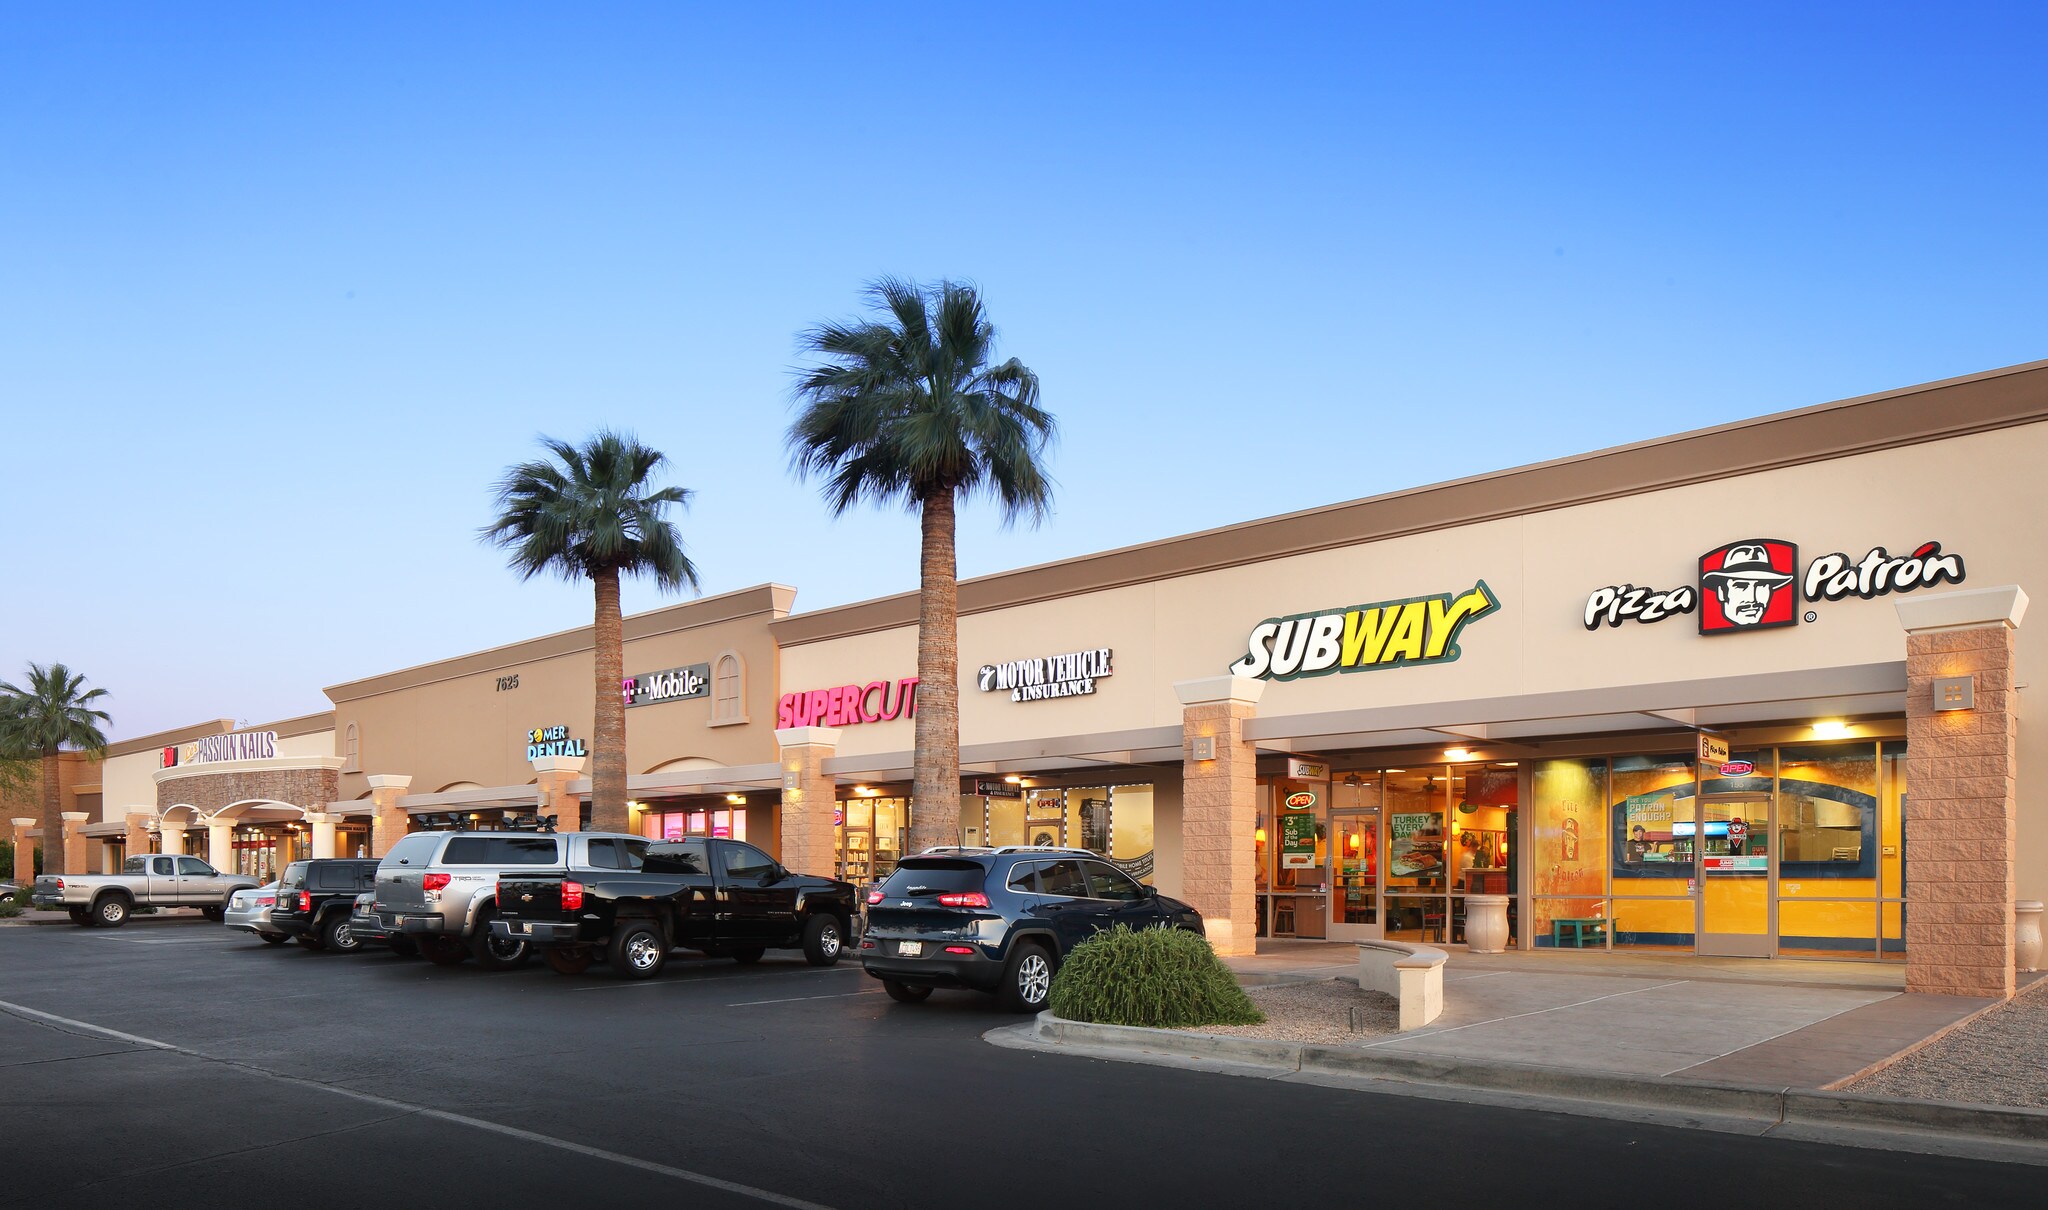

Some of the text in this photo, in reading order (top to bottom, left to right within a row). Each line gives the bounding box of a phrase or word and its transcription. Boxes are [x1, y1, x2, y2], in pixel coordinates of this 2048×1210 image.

[1584, 541, 1966, 631] Pizza Patrón
[1230, 586, 1492, 678] SUBWAY
[996, 648, 1112, 690] MOTOR VEHICLE
[496, 674, 519, 692] 7625
[1011, 678, 1096, 702] & INSURANCE
[777, 677, 919, 730] SUPERCUT
[527, 725, 567, 744] SOMER
[198, 734, 238, 763] PASSION
[239, 731, 275, 760] NAILS
[527, 738, 586, 762] DENTAL
[1297, 764, 1322, 777] SUBWAY
[1721, 764, 1752, 773] OPEN
[1290, 795, 1312, 805] OPEN
[1629, 803, 1665, 813] PATRON
[1393, 815, 1430, 824] TURKEY
[1629, 812, 1671, 822] ENOUGH?
[1284, 828, 1298, 836] Sub
[1394, 823, 1424, 832] EVERY
[1394, 831, 1412, 839] DAY
[1284, 839, 1299, 848] Day
